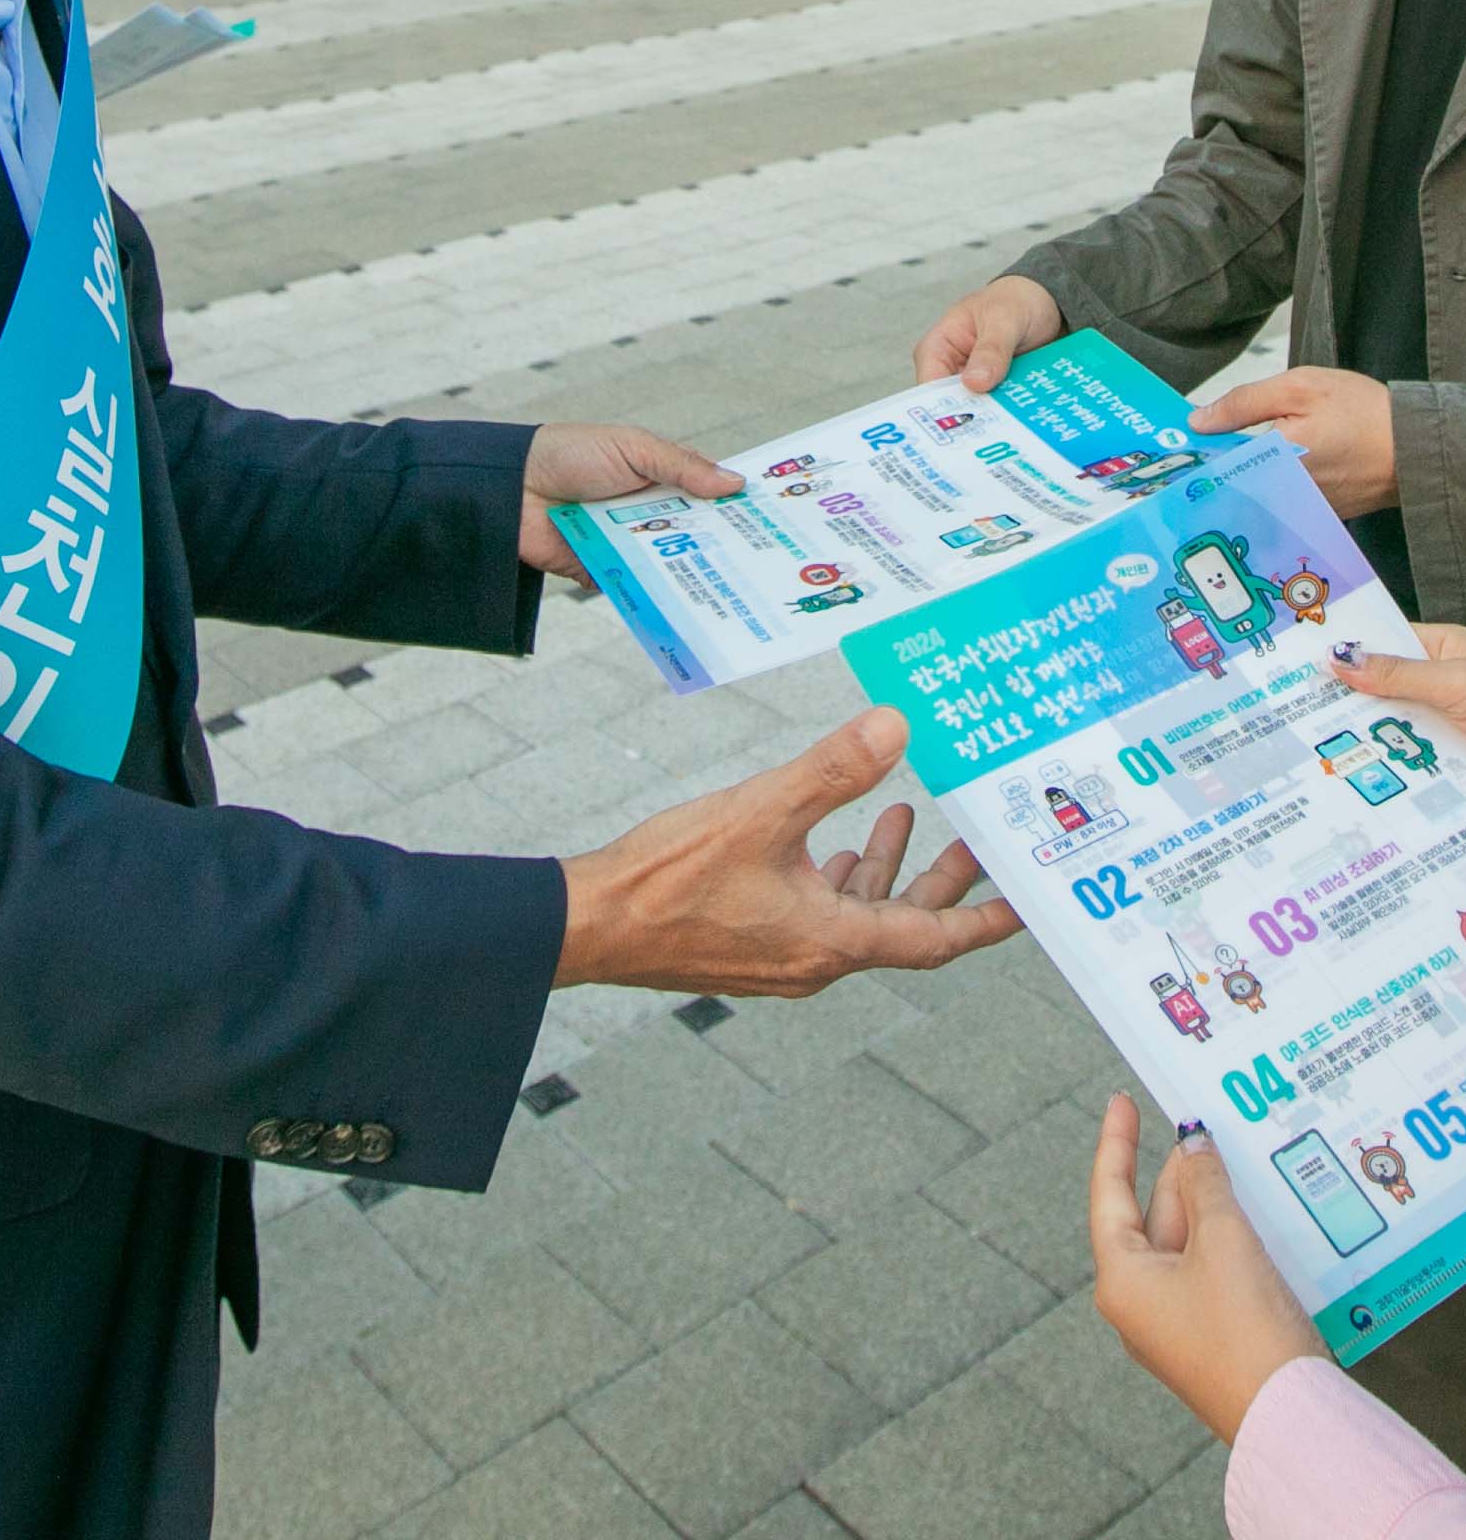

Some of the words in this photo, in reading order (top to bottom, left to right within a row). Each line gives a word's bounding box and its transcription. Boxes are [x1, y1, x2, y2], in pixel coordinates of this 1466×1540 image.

[860, 422, 905, 450] 02
[974, 441, 1018, 464] 01
[1185, 477, 1215, 502] SSiS
[1209, 447, 1279, 487] 한국사회보장정보원
[817, 492, 864, 515] 03
[651, 532, 699, 557] 05
[1114, 553, 1149, 578] 개인편
[893, 627, 945, 663] 2024
[911, 587, 1116, 692] 한국사회보장정보원과
[933, 683, 1003, 728] 국민이
[954, 712, 1032, 760] 정보보호
[1034, 668, 1124, 726] 실천수칙
[1163, 709, 1224, 744] 비밀번호는
[1227, 688, 1266, 713] 어렵게
[1267, 662, 1319, 694] 설정하기
[1118, 738, 1175, 786] 01
[1053, 837, 1073, 852] PW
[1079, 825, 1097, 839] 8자
[1095, 816, 1117, 830] 이상
[1129, 847, 1160, 869] 계정
[1158, 834, 1184, 854] 2차
[1182, 819, 1214, 841] 인증
[1213, 791, 1267, 825] 설정하기
[1145, 867, 1174, 886] 로그인
[1174, 860, 1186, 872] 시
[1184, 847, 1213, 865] 이메일
[1252, 811, 1281, 829] 모바일
[1152, 882, 1171, 898] 2차
[1168, 868, 1198, 889] 인증을
[1198, 848, 1232, 873] 설정하면
[1232, 843, 1246, 853] 내
[1244, 829, 1271, 847] 계정을
[1269, 810, 1306, 834] 안전하게
[1072, 865, 1142, 919] 02
[1181, 885, 1192, 895] 수
[1303, 886, 1321, 903] AI
[1318, 870, 1349, 894] 피싱
[1347, 841, 1401, 878] 조심하기
[1332, 894, 1357, 914] 기술을
[1355, 877, 1382, 900] 활용한
[1327, 905, 1364, 931] 발생하고
[1409, 867, 1429, 884] 요구
[1249, 897, 1318, 956] 03
[1338, 915, 1371, 940] 사실여부
[1173, 994, 1195, 1017] AI
[1279, 1040, 1304, 1062] QR
[1300, 1022, 1333, 1050] 코드
[1331, 996, 1376, 1030] 인식은
[1376, 964, 1430, 1004] 신중하게
[1428, 946, 1459, 970] 하기
[1297, 1058, 1326, 1081] 출처가
[1324, 1035, 1361, 1064] 불분명한
[1393, 1005, 1412, 1022] 스캔
[1306, 1058, 1353, 1092] 공공장소에
[1350, 1041, 1381, 1064] 노출된
[1378, 1032, 1395, 1048] QR
[1391, 1020, 1413, 1039] 코드
[1222, 1054, 1295, 1122] 04
